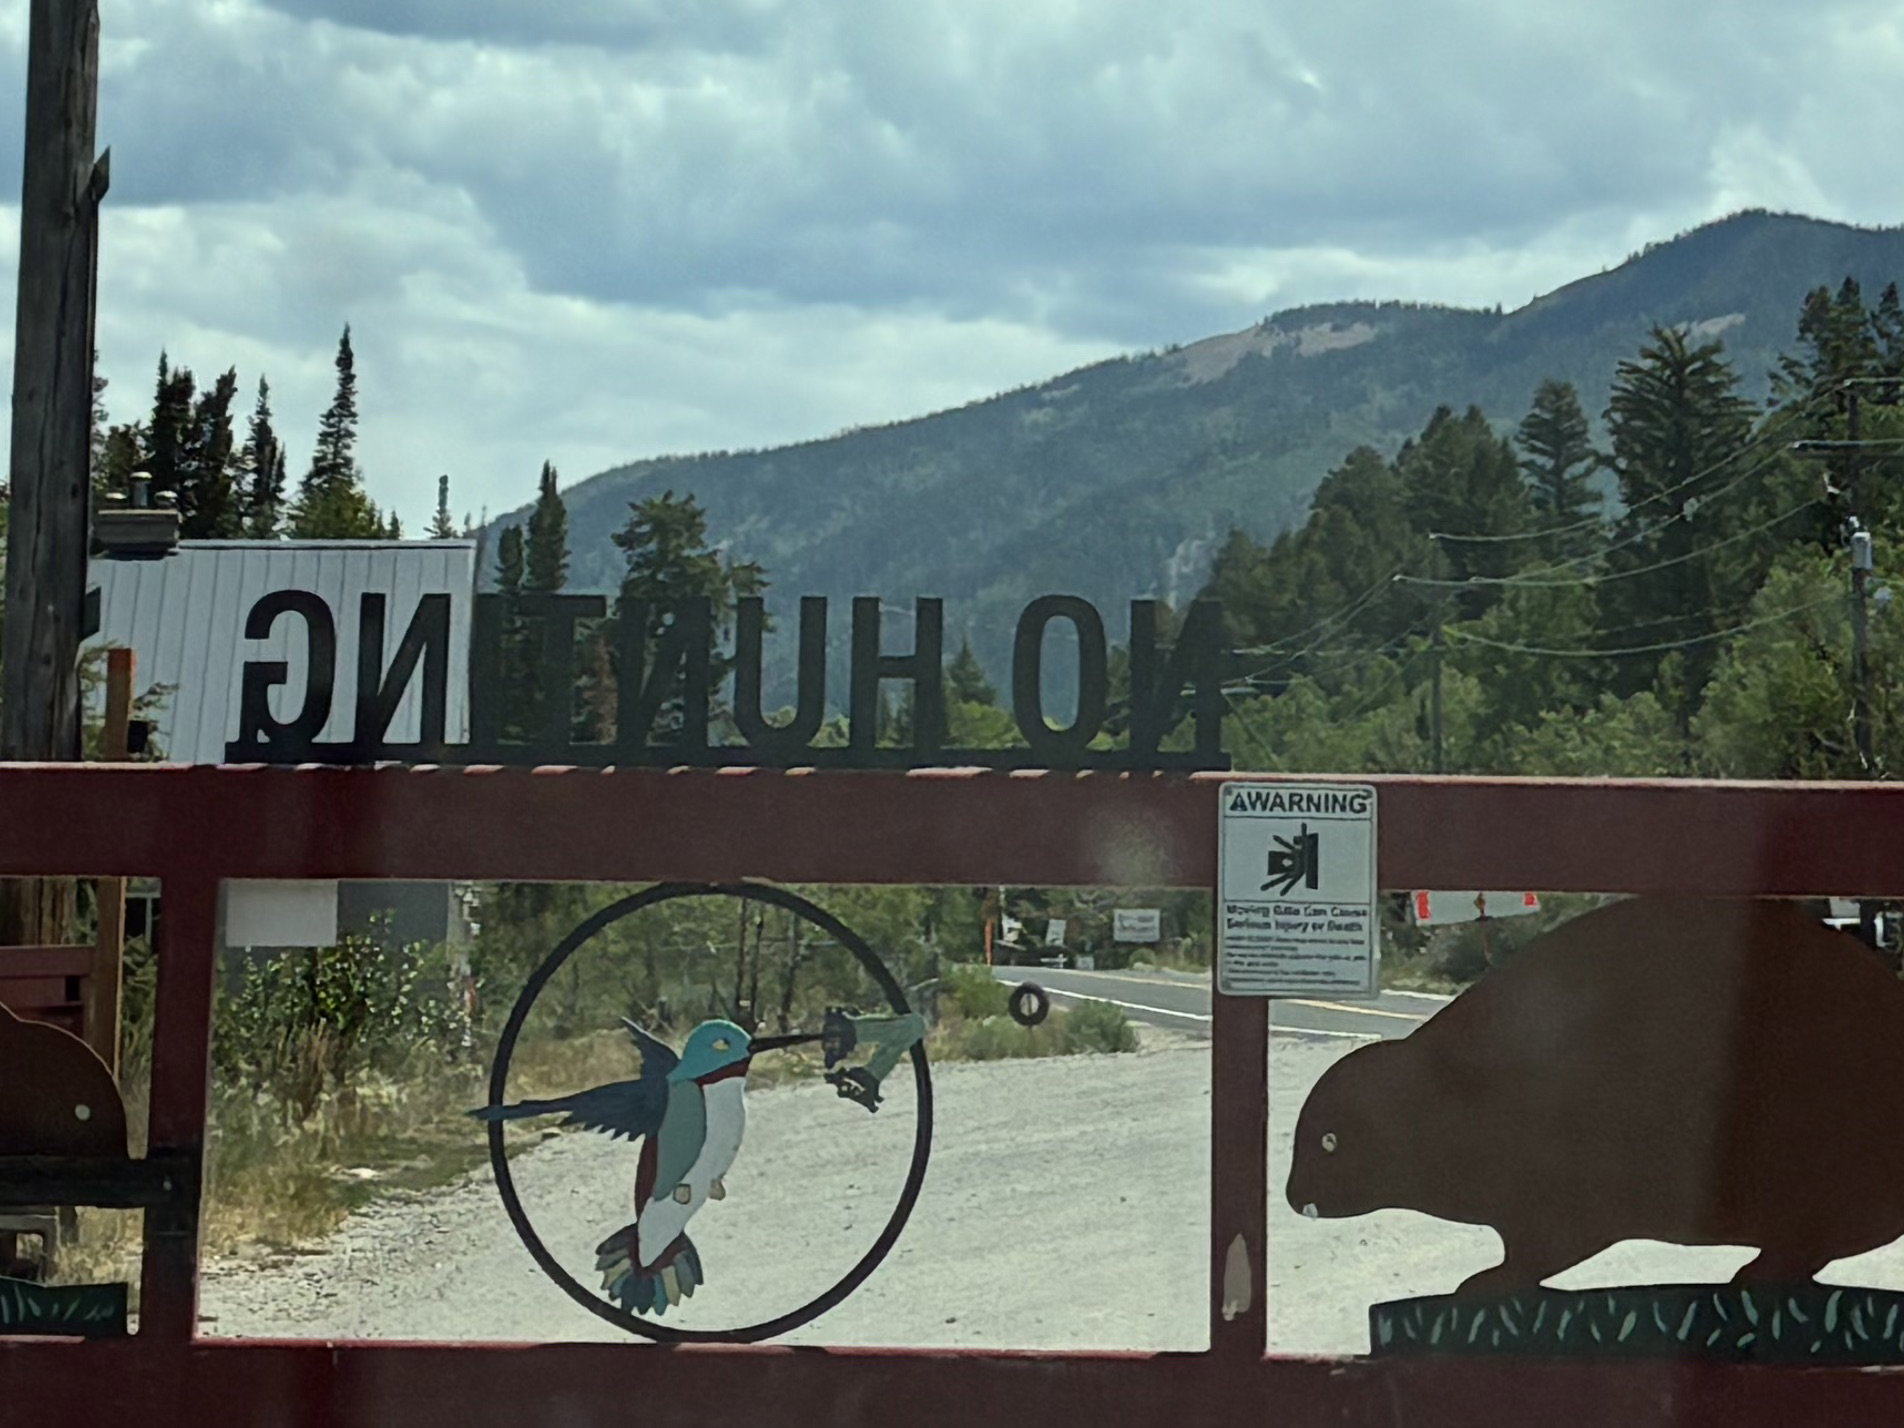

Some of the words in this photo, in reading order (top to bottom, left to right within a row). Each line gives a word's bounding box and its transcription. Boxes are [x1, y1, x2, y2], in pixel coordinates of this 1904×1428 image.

[1246, 791, 1368, 813] WARNING
[1303, 906, 1327, 917] Can
[1227, 918, 1272, 930] Serious
[1275, 920, 1309, 933] Injury
[1311, 922, 1324, 931] or
[1327, 921, 1363, 932] Death
